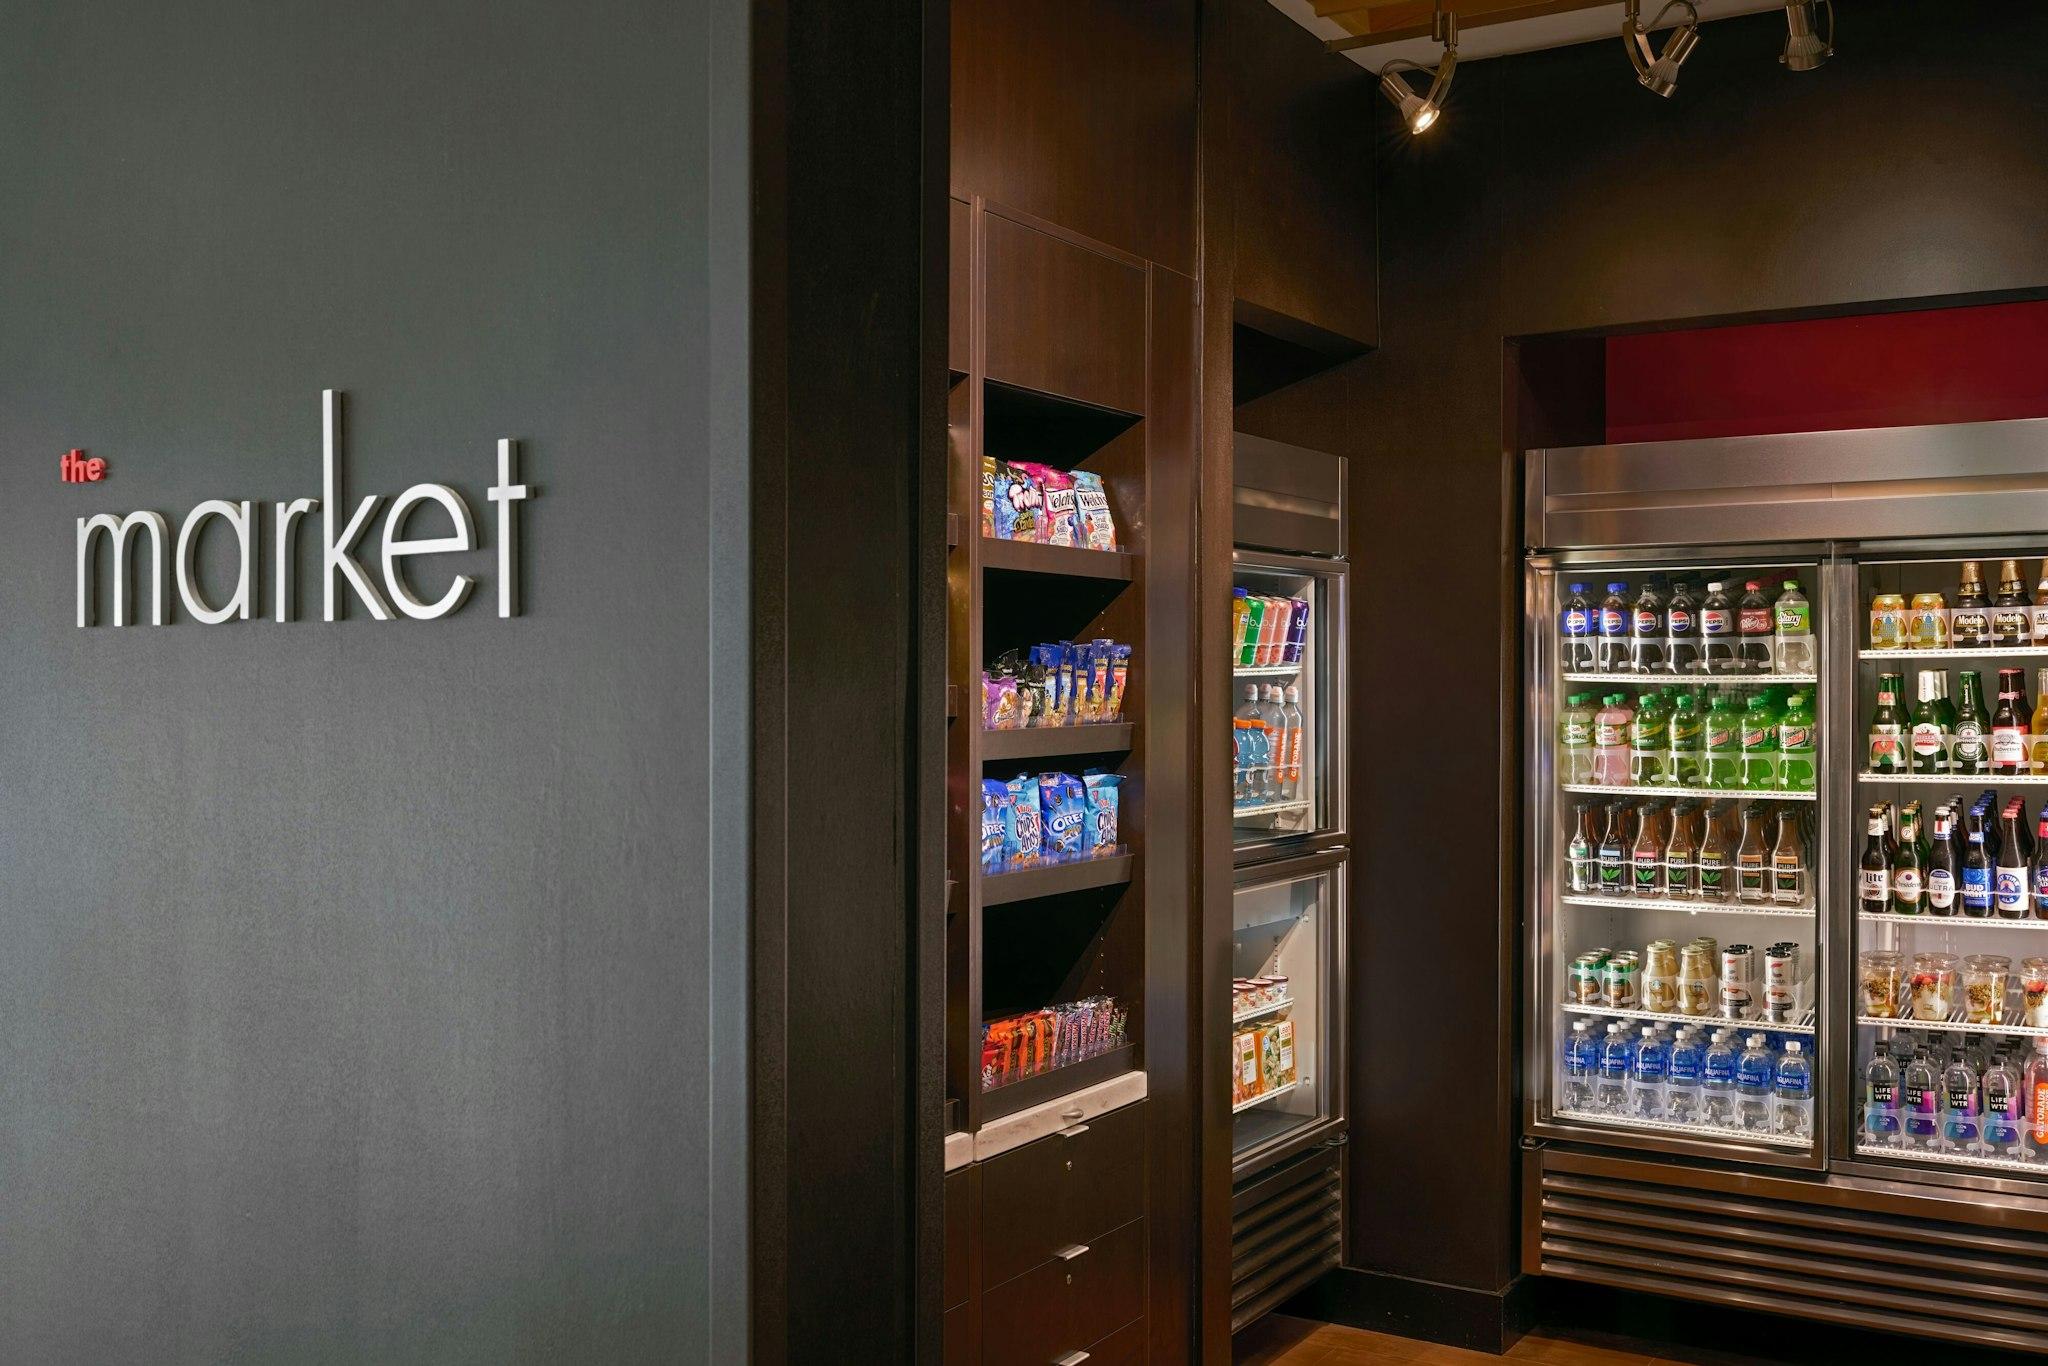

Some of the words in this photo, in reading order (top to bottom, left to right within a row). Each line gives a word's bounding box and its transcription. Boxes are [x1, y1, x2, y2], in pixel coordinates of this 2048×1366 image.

[60, 449, 105, 483] the
[1079, 493, 1108, 507] Welch's
[76, 388, 530, 628] market
[1958, 614, 1984, 625] Modelo
[1996, 613, 2022, 624] Modelo
[1702, 858, 1721, 866] PURE
[1865, 872, 1884, 883] Lite
[1704, 1068, 1730, 1076] AQUAFINA
[1736, 1073, 1760, 1082] AQUAFINA
[1777, 1076, 1803, 1086] AQUAFINA
[1990, 1096, 2008, 1104] LIFE
